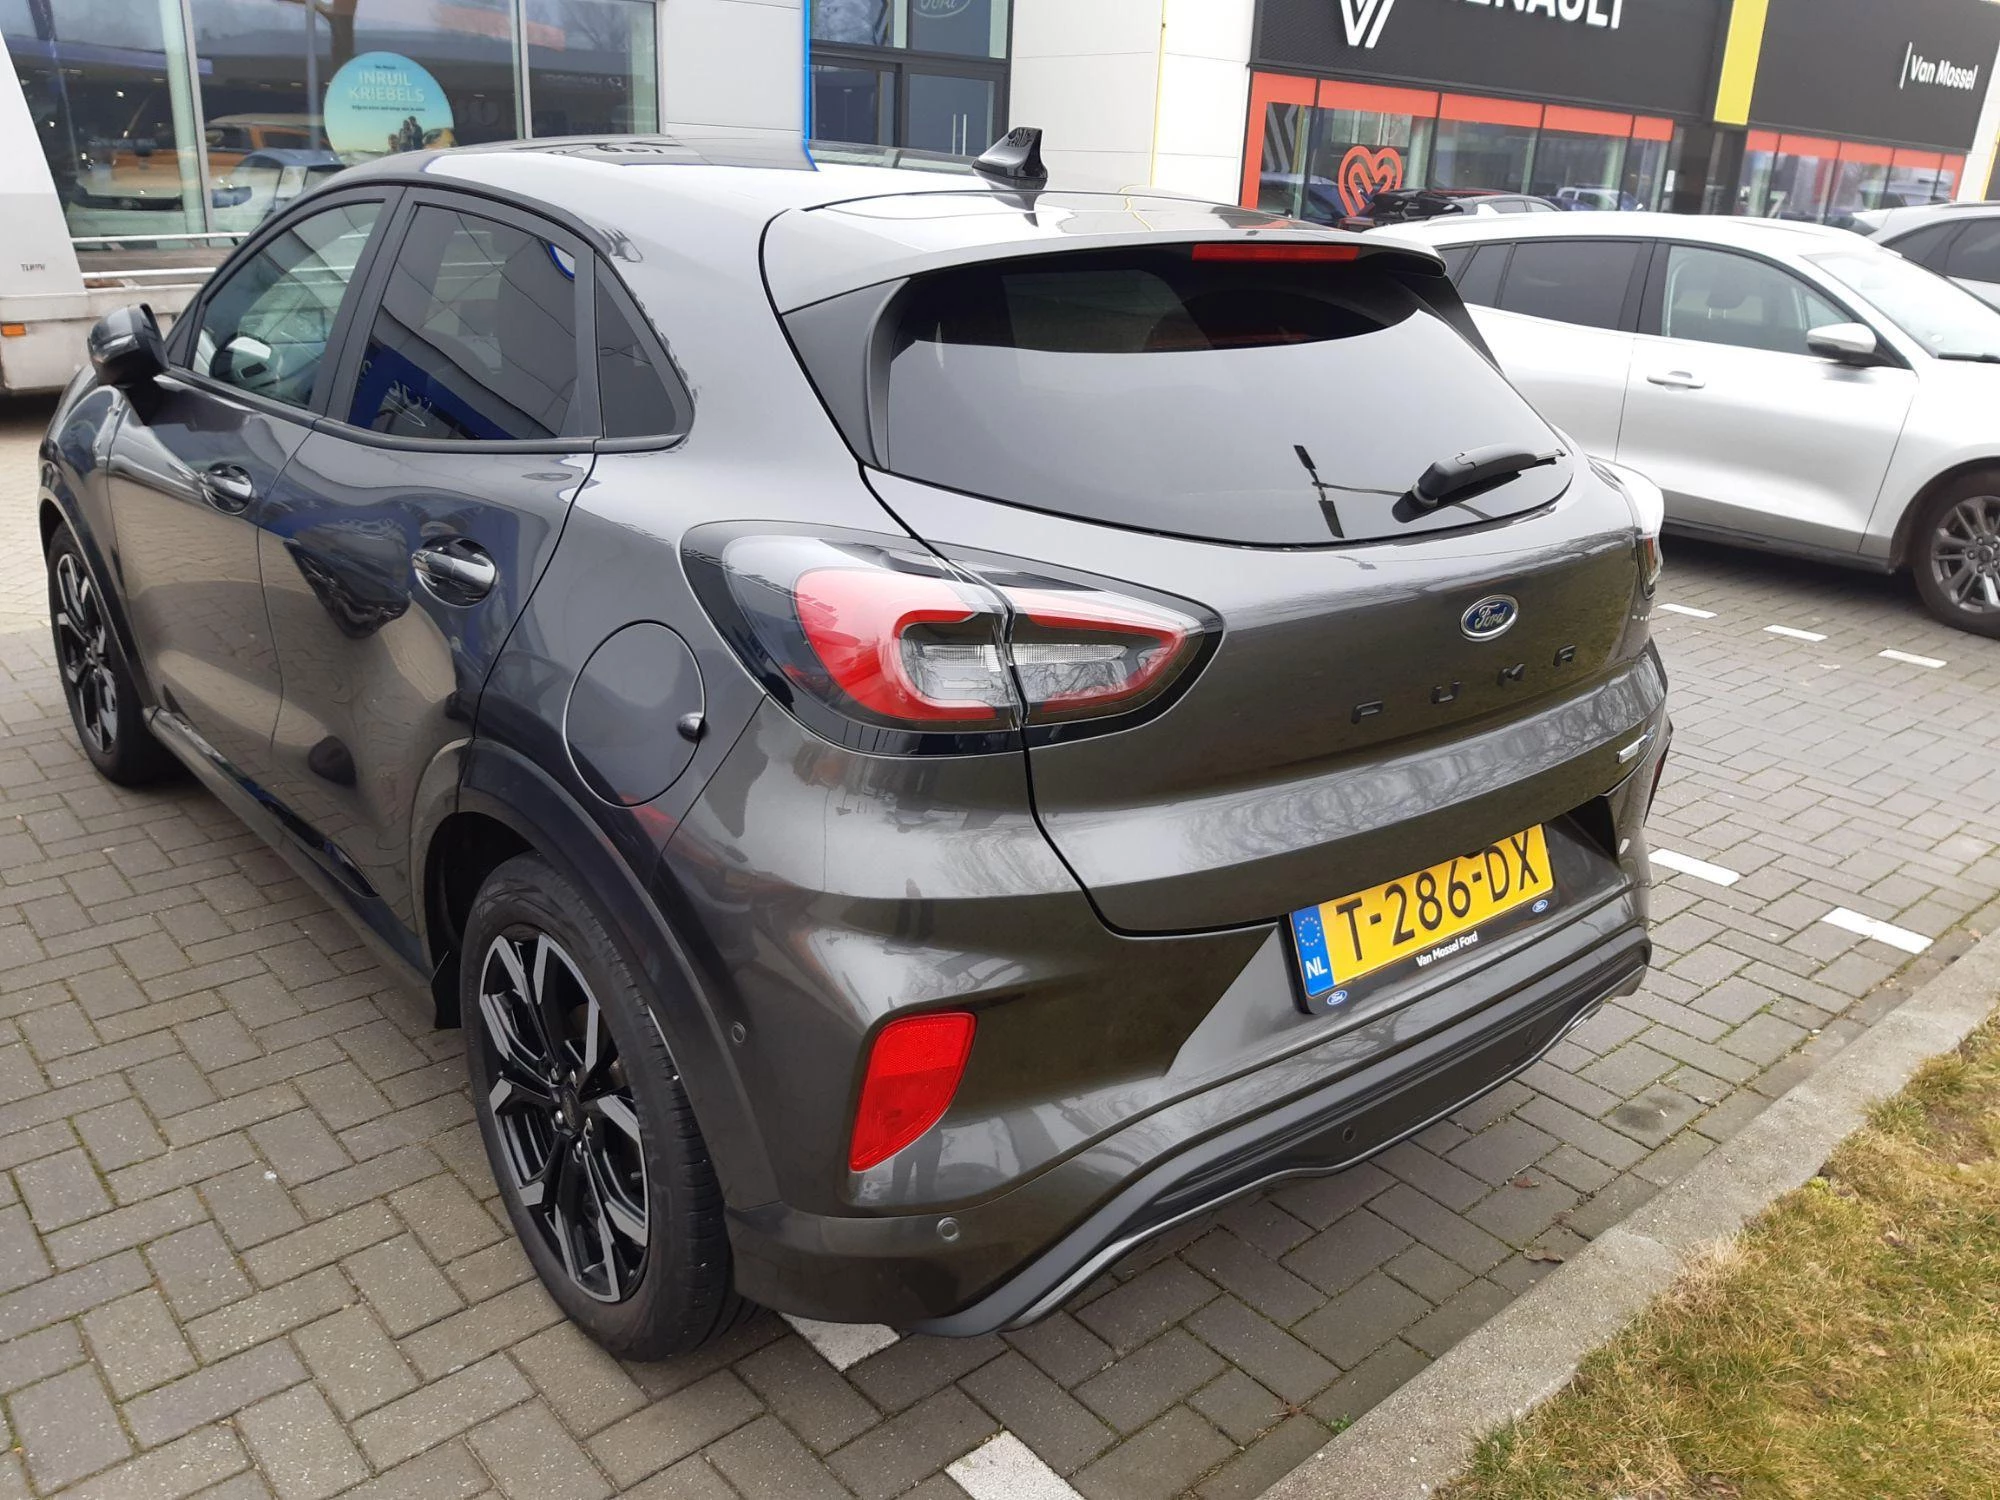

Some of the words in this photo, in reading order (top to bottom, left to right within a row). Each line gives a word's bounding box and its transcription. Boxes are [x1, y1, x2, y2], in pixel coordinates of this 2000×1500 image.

[1466, 0, 1622, 29] AULT
[360, 69, 412, 86] INRUIL
[1911, 54, 1936, 84] Van
[1935, 59, 1979, 90] Mossel
[349, 86, 425, 103] KRIEBELS
[1474, 603, 1506, 630] Ford
[1351, 645, 1577, 725] PUMA
[1336, 830, 1539, 961] T-286-DX
[1415, 954, 1433, 967] Van
[1432, 939, 1459, 960] Mossel
[1459, 930, 1479, 948] Ford
[1305, 957, 1328, 980] NL
